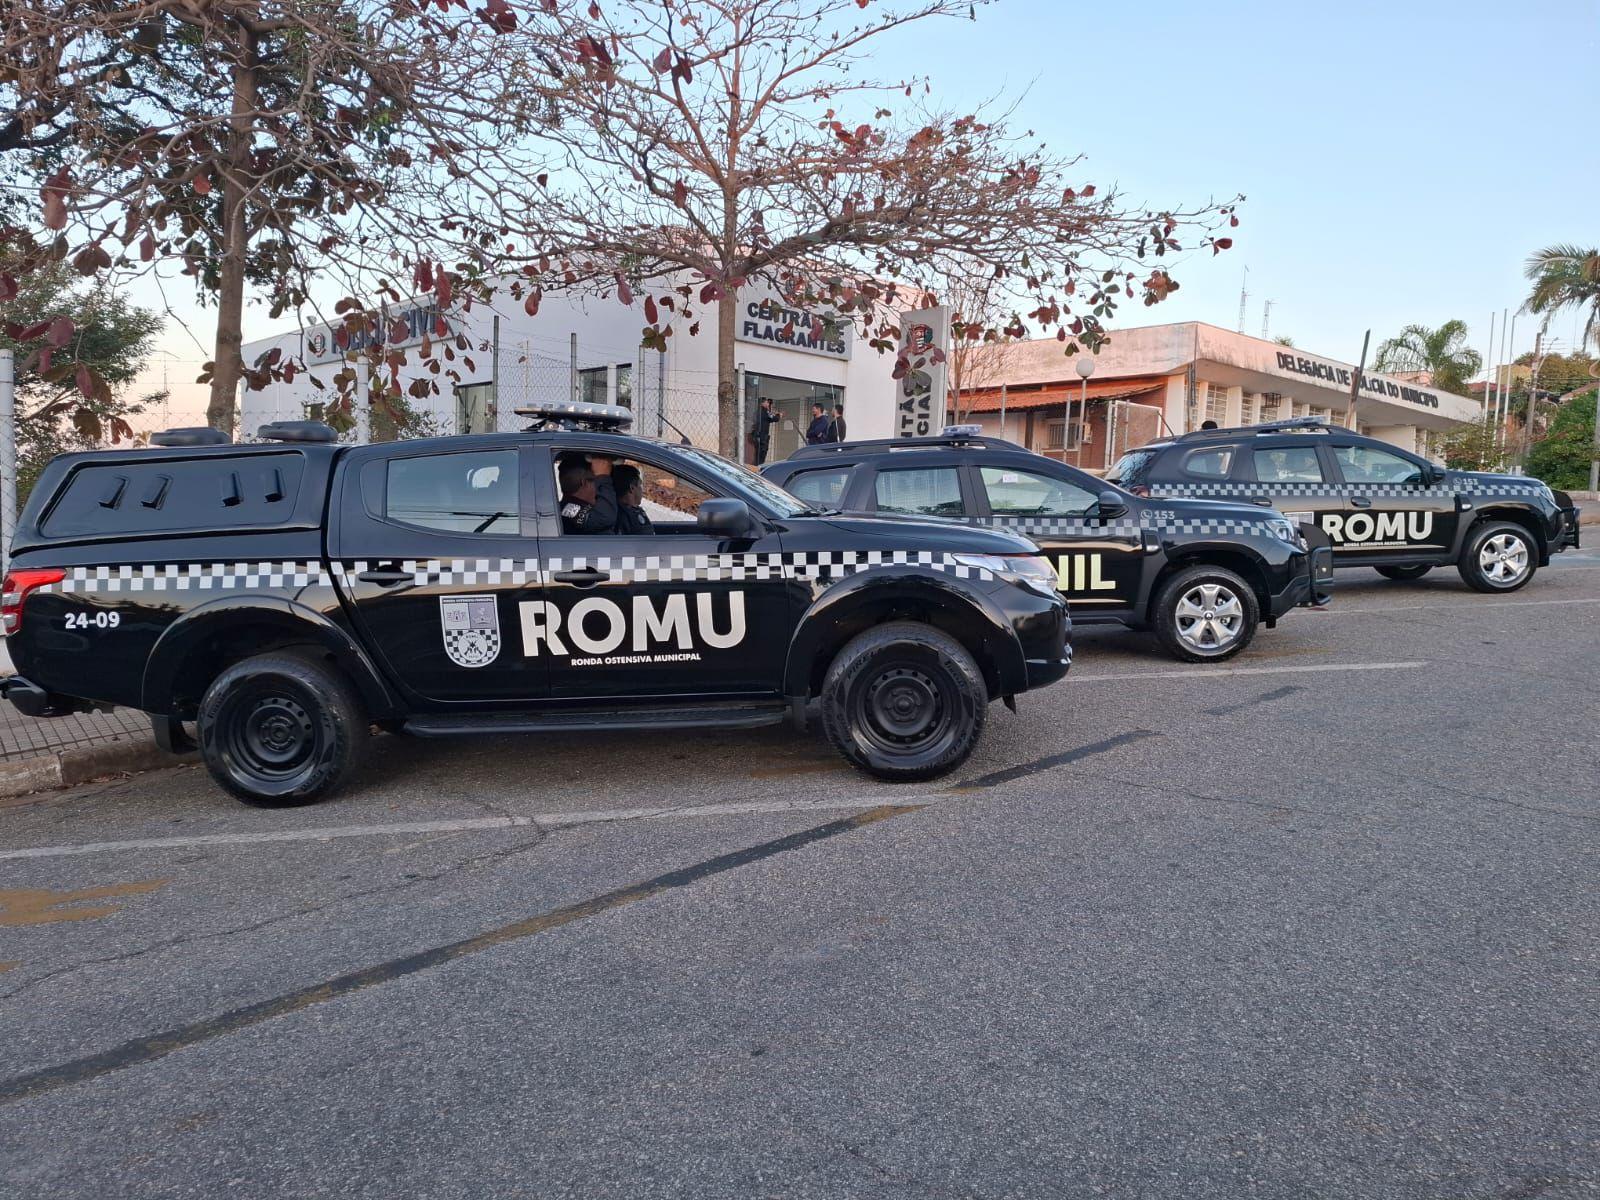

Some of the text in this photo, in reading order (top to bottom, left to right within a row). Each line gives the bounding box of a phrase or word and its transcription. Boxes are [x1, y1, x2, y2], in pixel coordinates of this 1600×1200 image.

[1336, 367, 1351, 386] DE
[1153, 510, 1175, 520] 153
[1322, 511, 1433, 542] ROMU
[64, 611, 120, 629] 24-09
[518, 590, 747, 657] ROMU
[571, 653, 701, 666] RONDA OSTENSIVA MUNICIPAL
